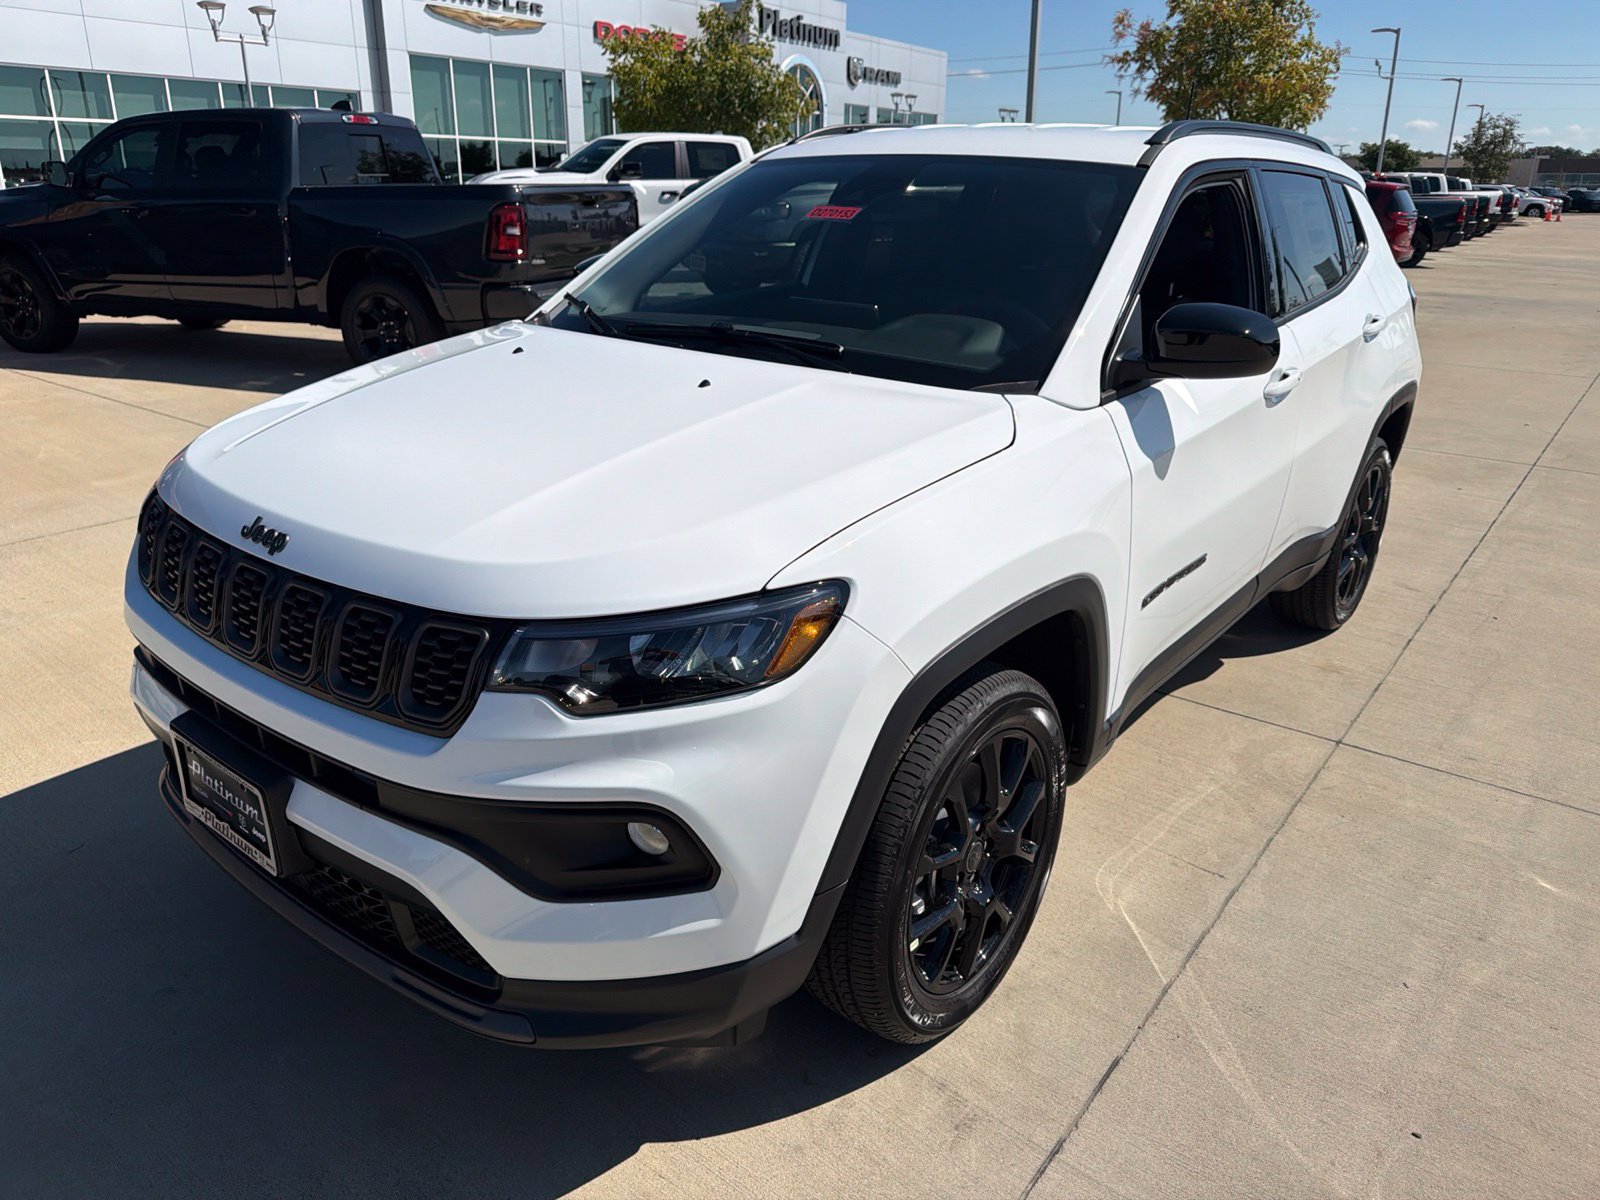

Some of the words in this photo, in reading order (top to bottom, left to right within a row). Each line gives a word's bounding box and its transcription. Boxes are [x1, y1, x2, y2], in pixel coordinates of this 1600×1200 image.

[759, 8, 841, 50] Platinum
[863, 67, 902, 87] RAM
[240, 516, 290, 556] Jeep
[187, 760, 264, 826] Platinum
[204, 807, 260, 860] Platinum
